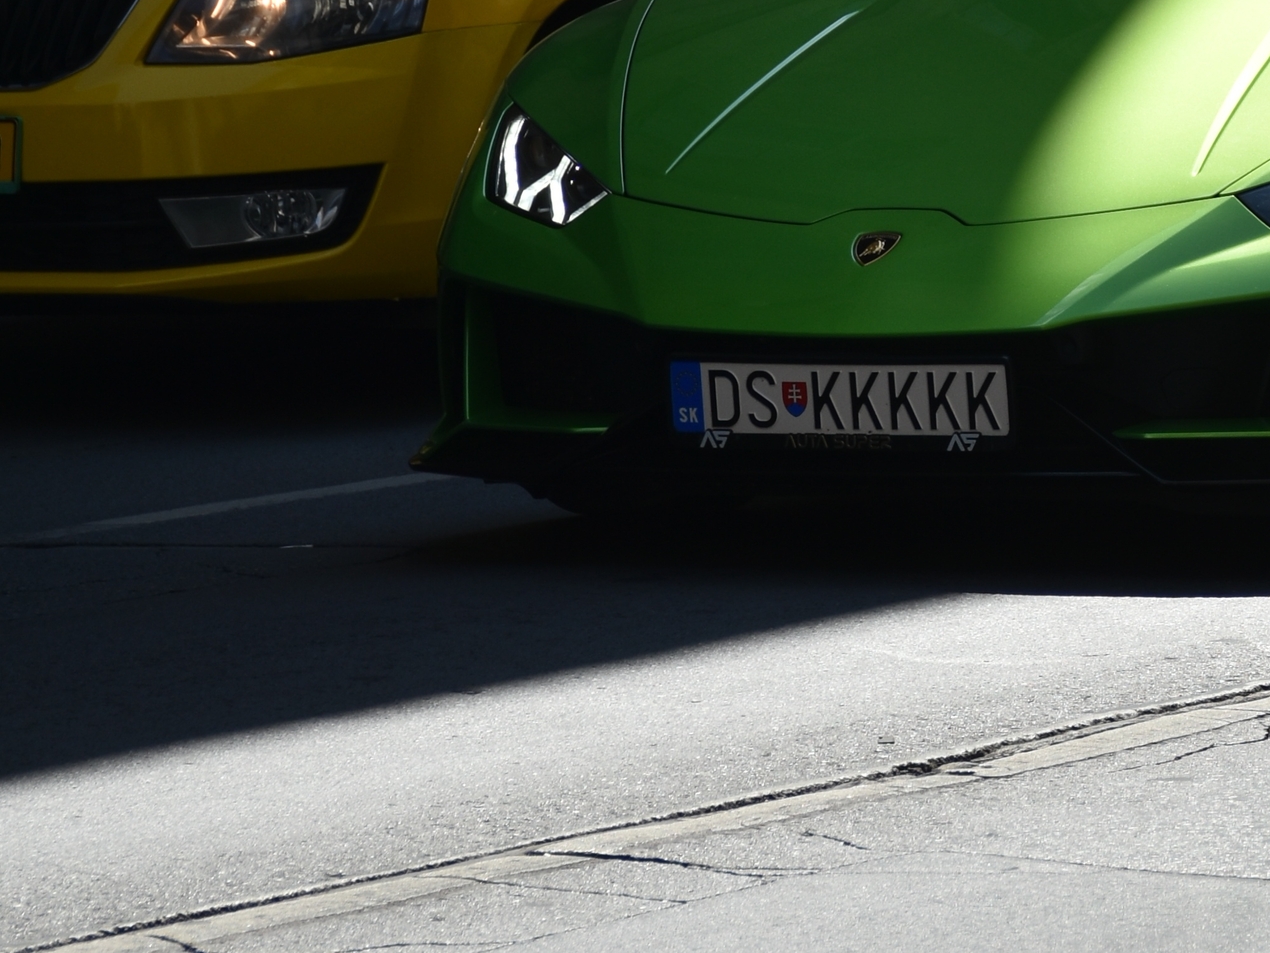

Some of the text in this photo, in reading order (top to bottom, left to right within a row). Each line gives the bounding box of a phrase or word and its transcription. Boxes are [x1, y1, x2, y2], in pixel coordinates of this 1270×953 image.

[678, 407, 699, 424] SK
[707, 369, 1000, 430] DS KKKKK
